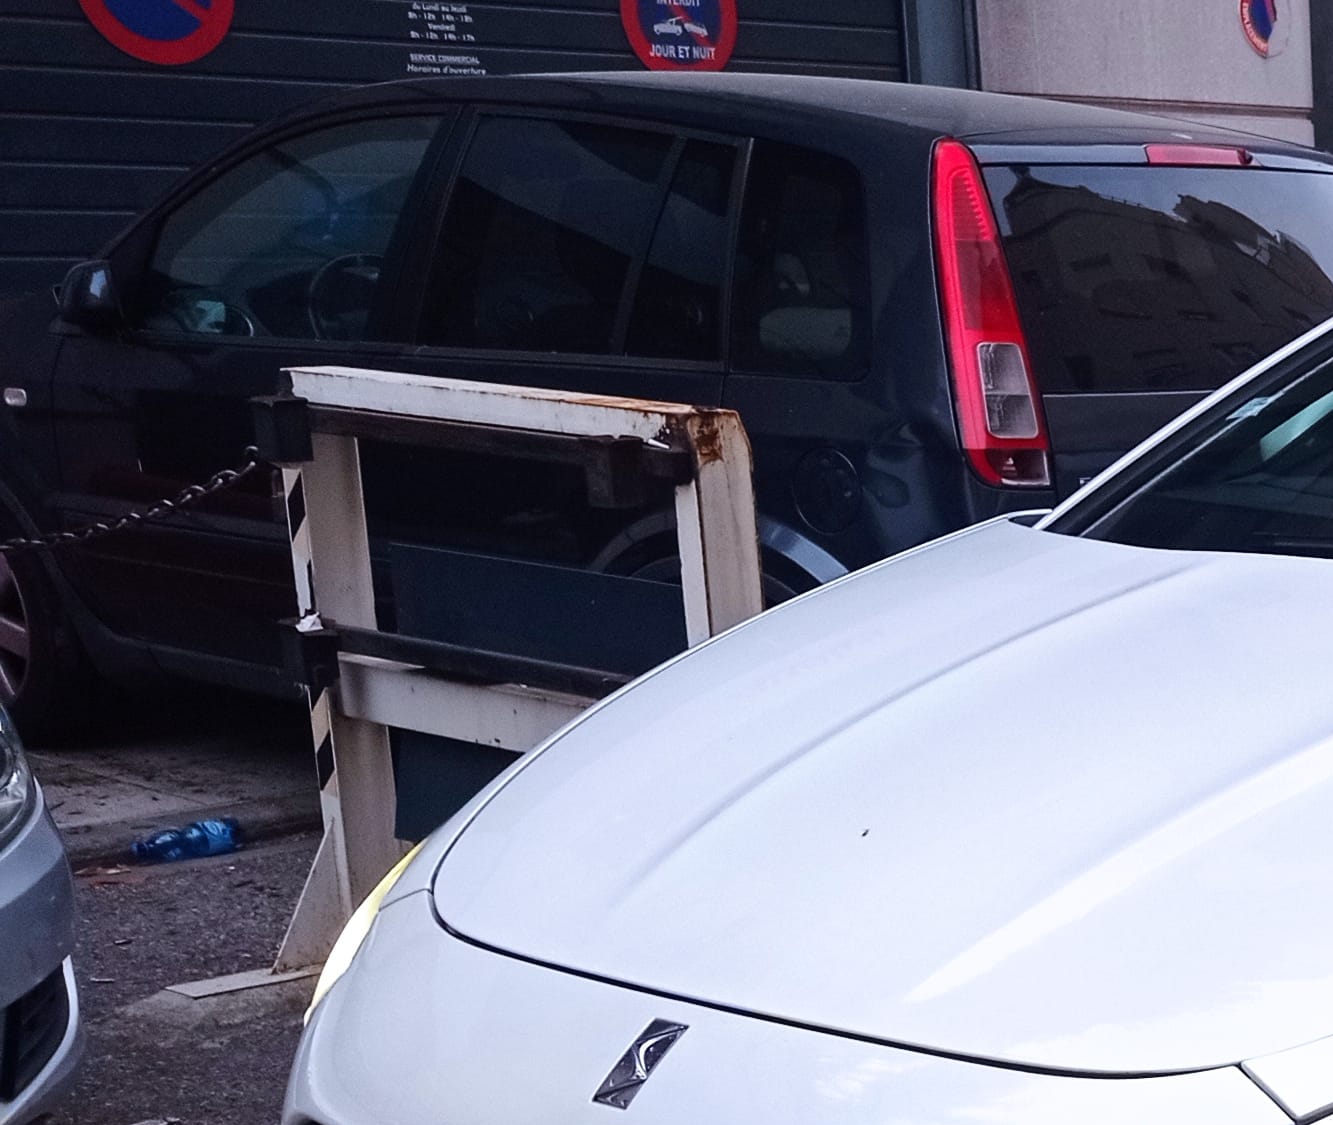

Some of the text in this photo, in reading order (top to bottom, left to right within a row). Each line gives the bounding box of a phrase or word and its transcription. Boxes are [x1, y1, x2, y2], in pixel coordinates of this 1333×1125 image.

[649, 44, 716, 60] JOUR ET NUIT
[407, 64, 441, 73] Horaires
